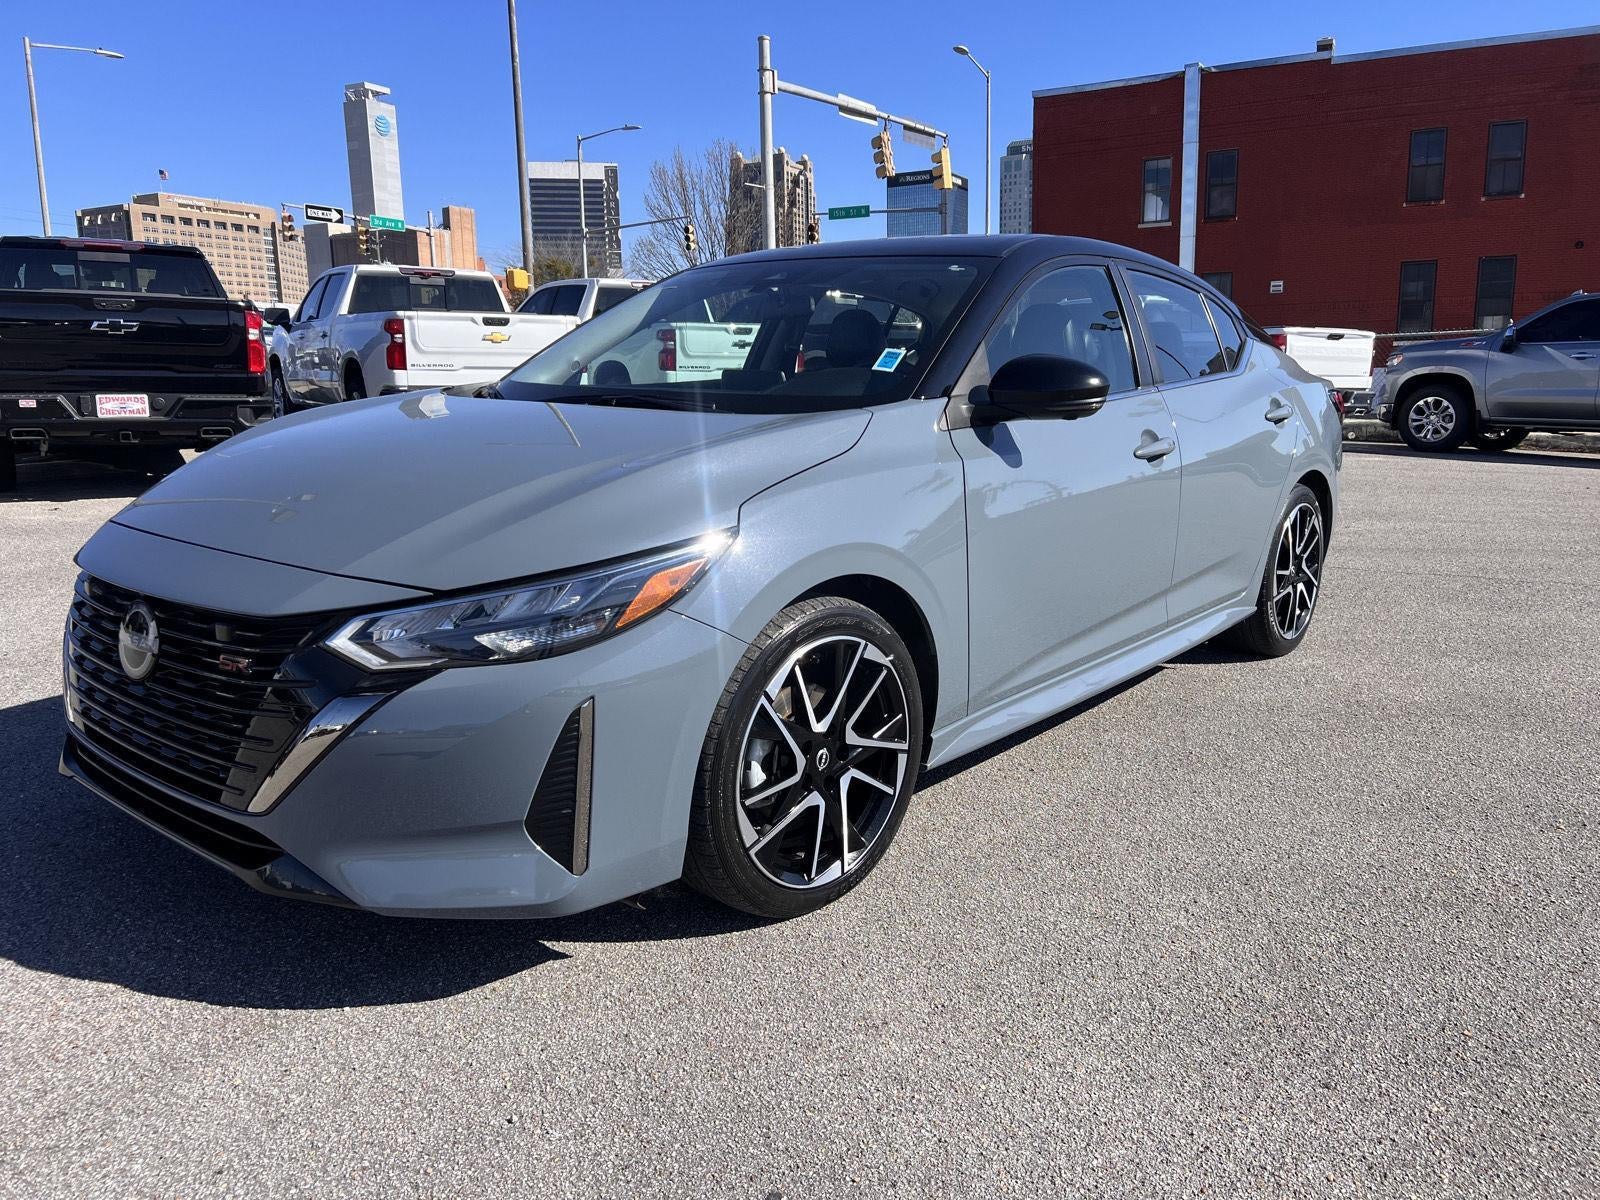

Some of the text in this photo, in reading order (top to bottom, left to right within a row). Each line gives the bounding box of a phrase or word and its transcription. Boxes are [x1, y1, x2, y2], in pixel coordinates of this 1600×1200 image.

[906, 174, 930, 182] REGIONS
[608, 169, 616, 216] LUXURY
[833, 209, 846, 217] 15th
[373, 218, 383, 226] 3rd
[385, 219, 395, 228] Ave
[98, 396, 146, 405] EDWARDS
[99, 406, 147, 416] CHEVYMAN
[219, 653, 252, 673] SR
